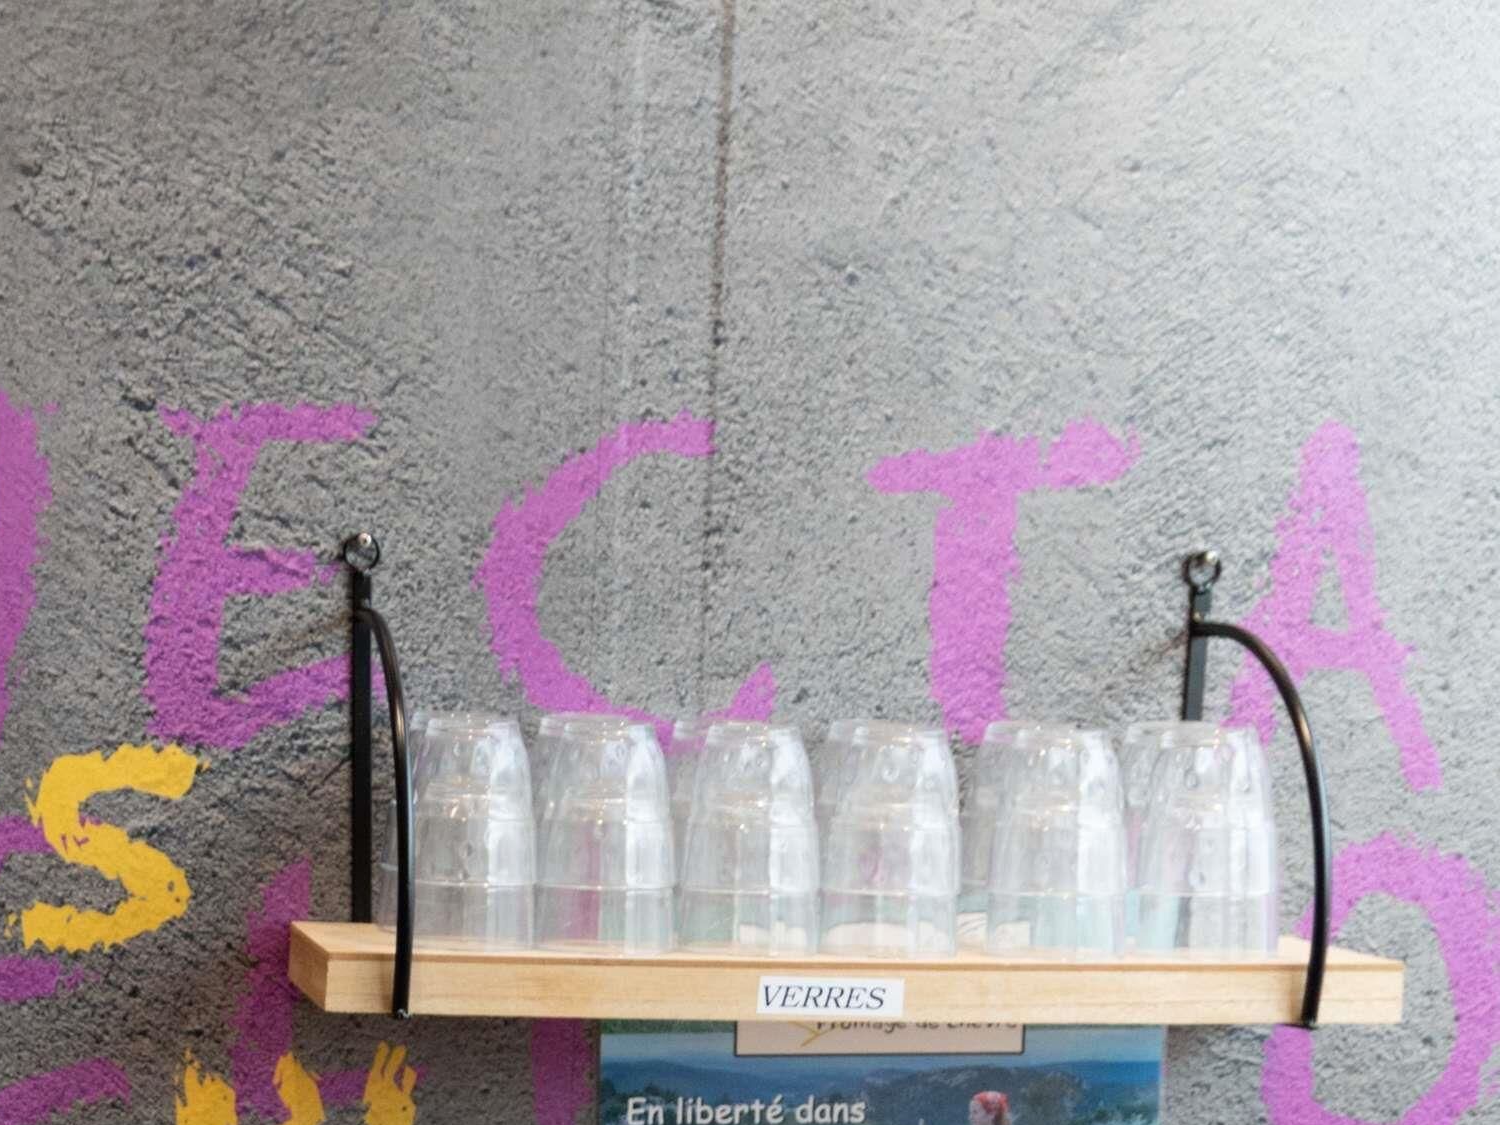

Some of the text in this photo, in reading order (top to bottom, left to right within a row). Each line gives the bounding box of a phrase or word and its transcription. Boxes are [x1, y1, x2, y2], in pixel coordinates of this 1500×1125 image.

[763, 984, 886, 1010] VERRES
[675, 1093, 785, 1125] liberté
[794, 1094, 867, 1124] dans
